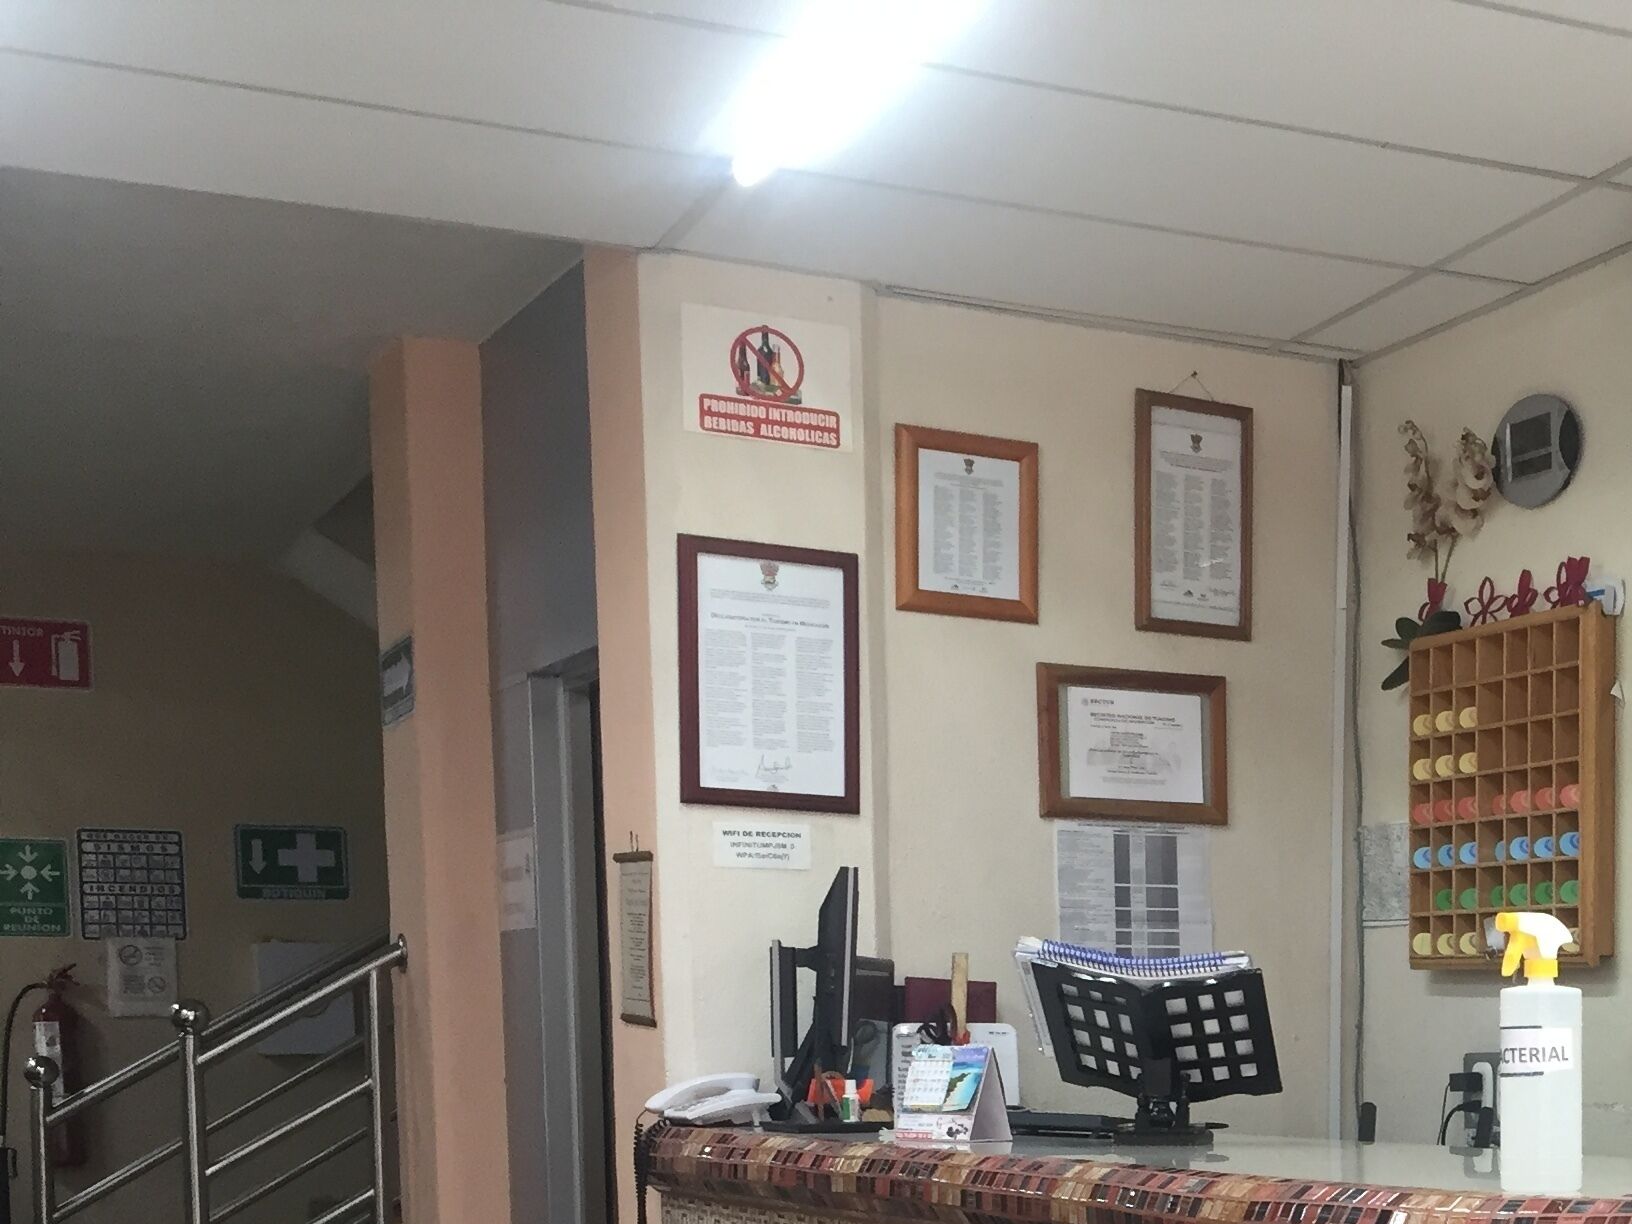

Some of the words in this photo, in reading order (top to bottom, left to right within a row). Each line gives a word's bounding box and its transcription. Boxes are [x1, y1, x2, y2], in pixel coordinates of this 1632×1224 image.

[703, 398, 766, 419] PROHIBIDO
[768, 407, 837, 429] INTRODUCIR
[704, 415, 754, 435] BEBIDAS
[760, 424, 837, 446] ALCOHOLICAS
[89, 884, 176, 894] INCENDIOS
[9, 907, 53, 916] PUNTO
[1501, 1045, 1569, 1064] CTERIAL
